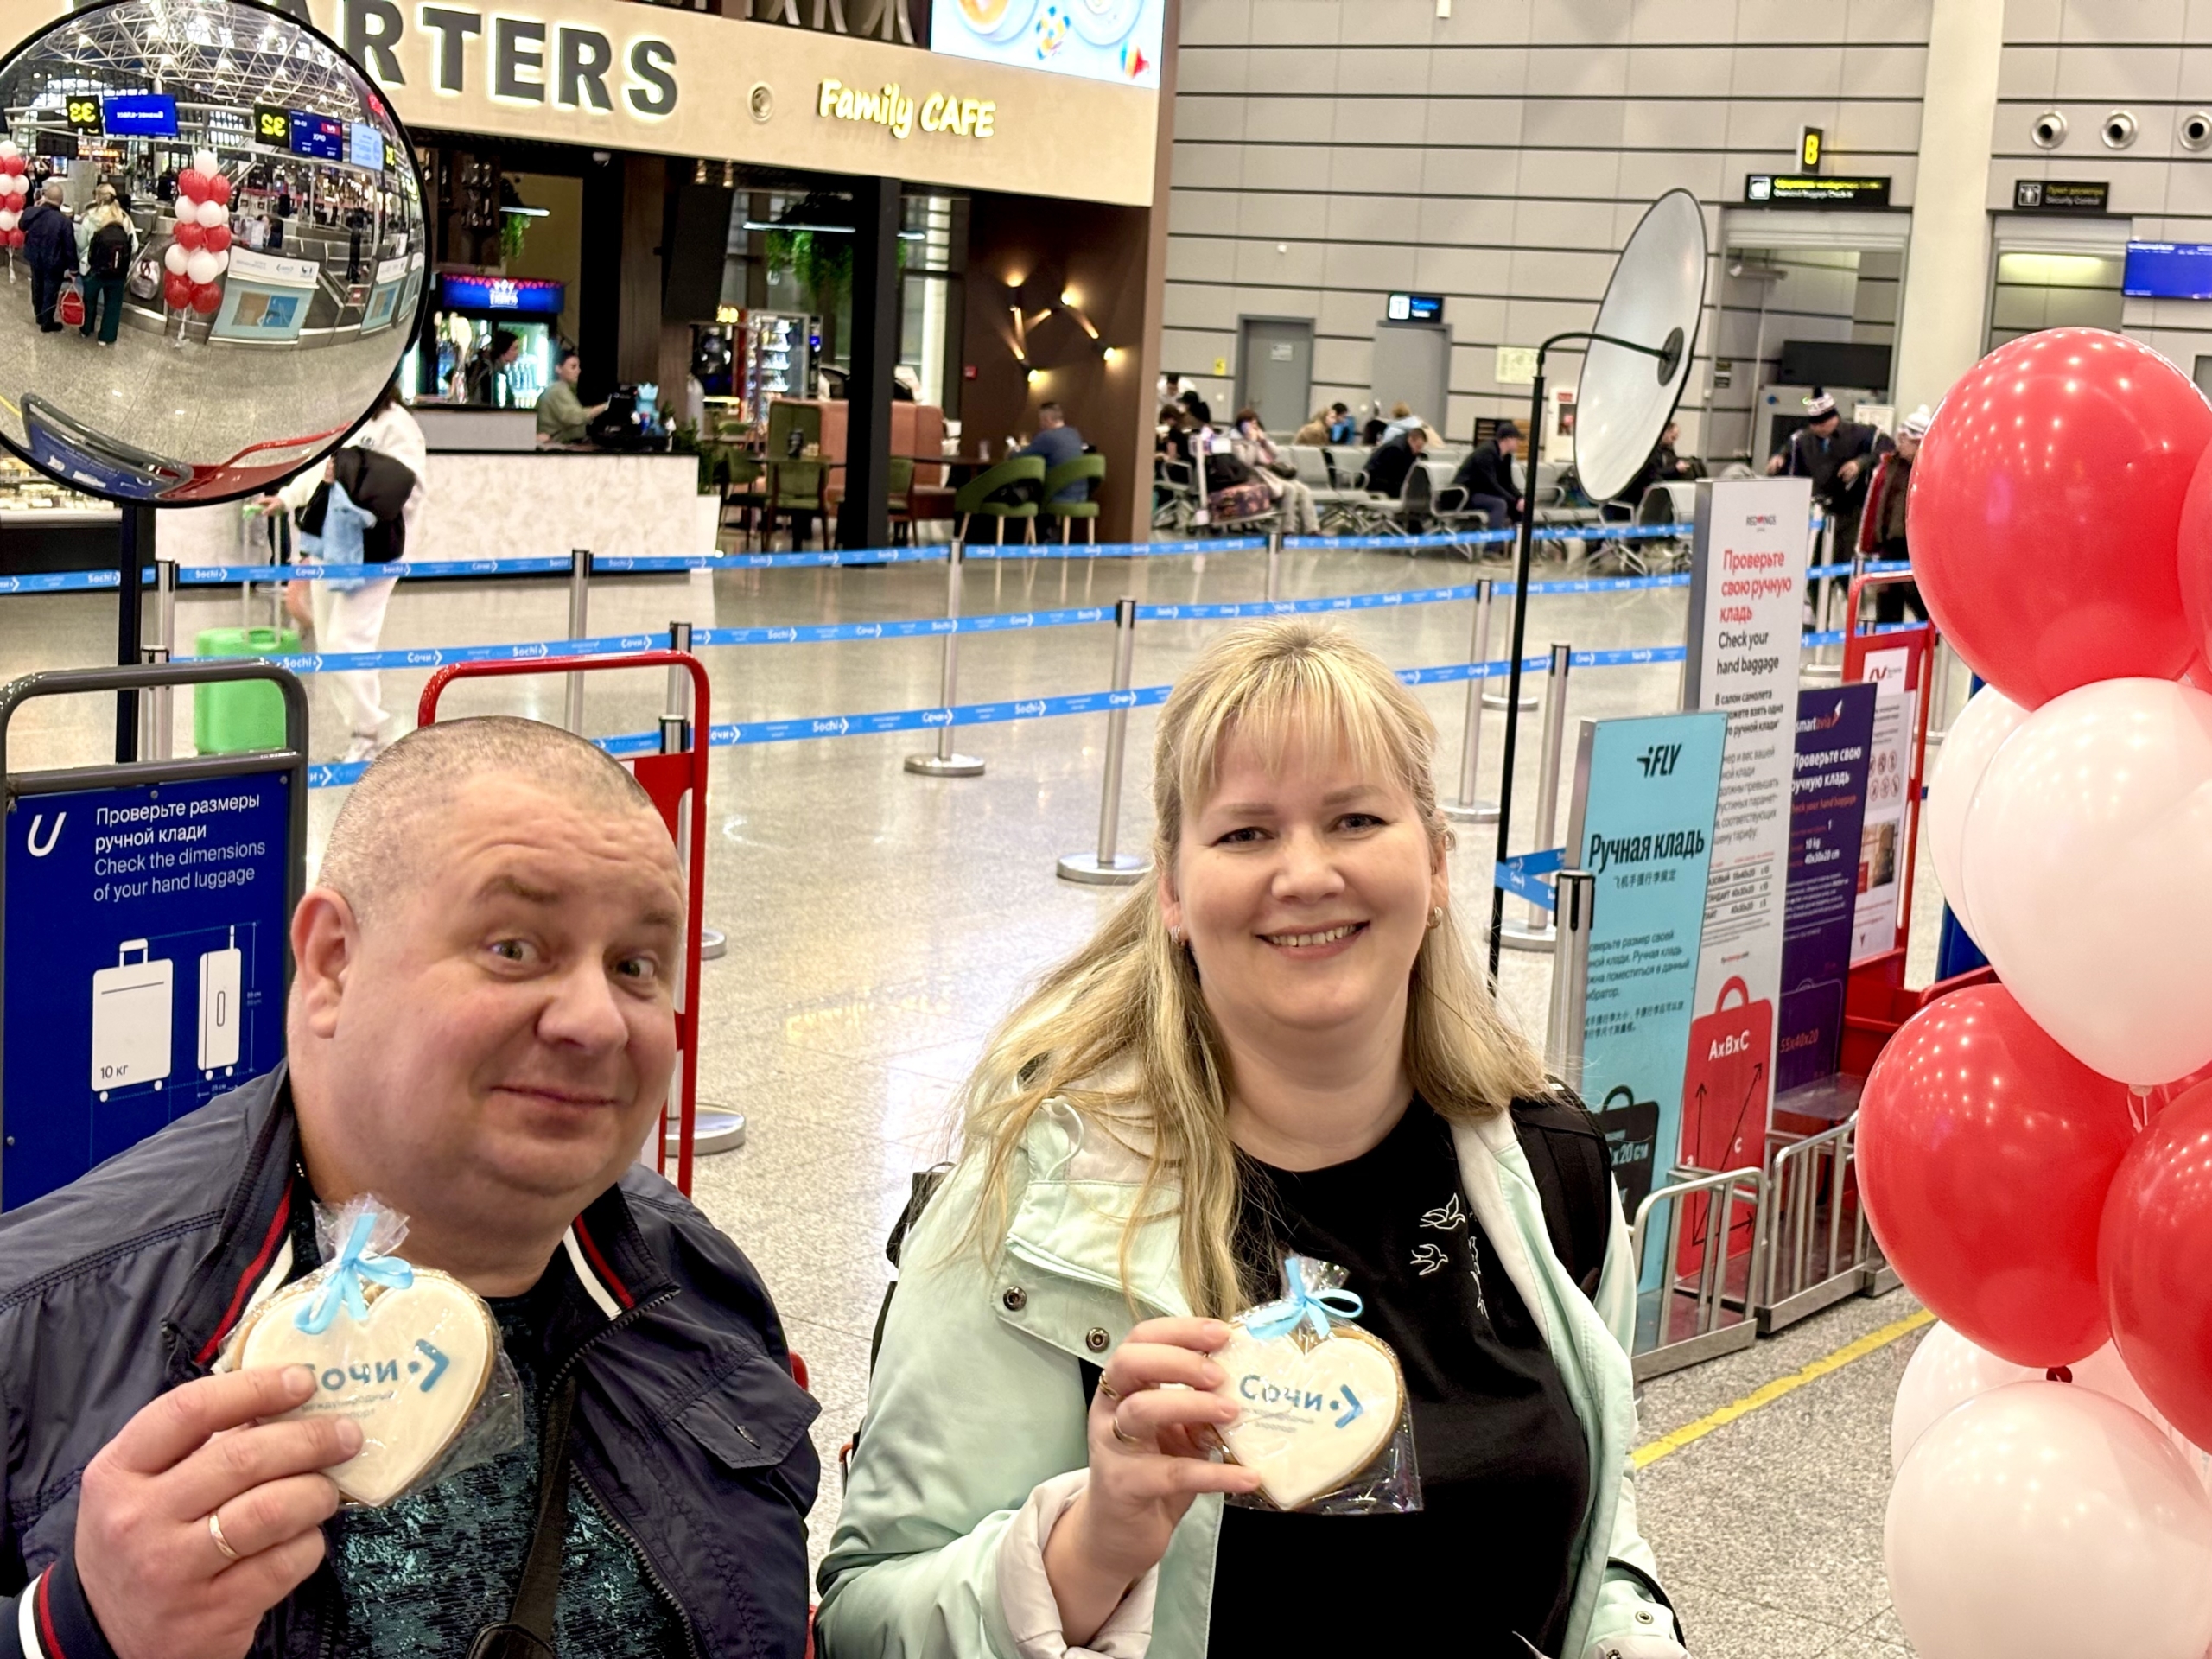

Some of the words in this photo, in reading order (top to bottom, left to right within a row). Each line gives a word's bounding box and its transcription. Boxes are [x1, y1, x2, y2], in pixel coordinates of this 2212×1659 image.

[819, 78, 914, 139] Family
[920, 92, 997, 138] CAFE
[1723, 550, 1784, 575] Проверьте
[88, 574, 112, 584] Sochi
[195, 569, 218, 579] Sochi
[1721, 580, 1750, 596] свою
[1751, 577, 1792, 600] ручную
[1719, 606, 1752, 624] кладь
[1719, 631, 1746, 649] Check
[1749, 632, 1769, 650] your
[407, 653, 432, 664] Сочи
[512, 645, 539, 658] Sochi
[284, 657, 313, 669] Sochi
[1717, 656, 1739, 675] hand
[1741, 654, 1779, 675] baggage
[1014, 702, 1039, 715] Sochi
[812, 720, 840, 734] Sochi
[1840, 747, 1861, 761] свою
[1824, 771, 1850, 787] кладь
[96, 801, 185, 828] Проверьте
[190, 793, 260, 819] размеры
[95, 827, 155, 855] ручной
[159, 824, 207, 844] клади
[95, 852, 146, 877] Check
[149, 851, 175, 869] the
[179, 840, 266, 865] dimensions
[1588, 833, 1651, 874] Ручная
[1654, 830, 1704, 860] кладь
[93, 885, 110, 901] of
[113, 880, 148, 903] your
[152, 876, 190, 895] hand
[194, 868, 255, 892] luggage
[1622, 934, 1650, 949] размер
[1632, 950, 1659, 964] Ручная
[100, 1065, 114, 1078] 10
[117, 1065, 129, 1077] кг
[304, 1359, 398, 1391] очи
[1240, 1374, 1323, 1412] Сочи
